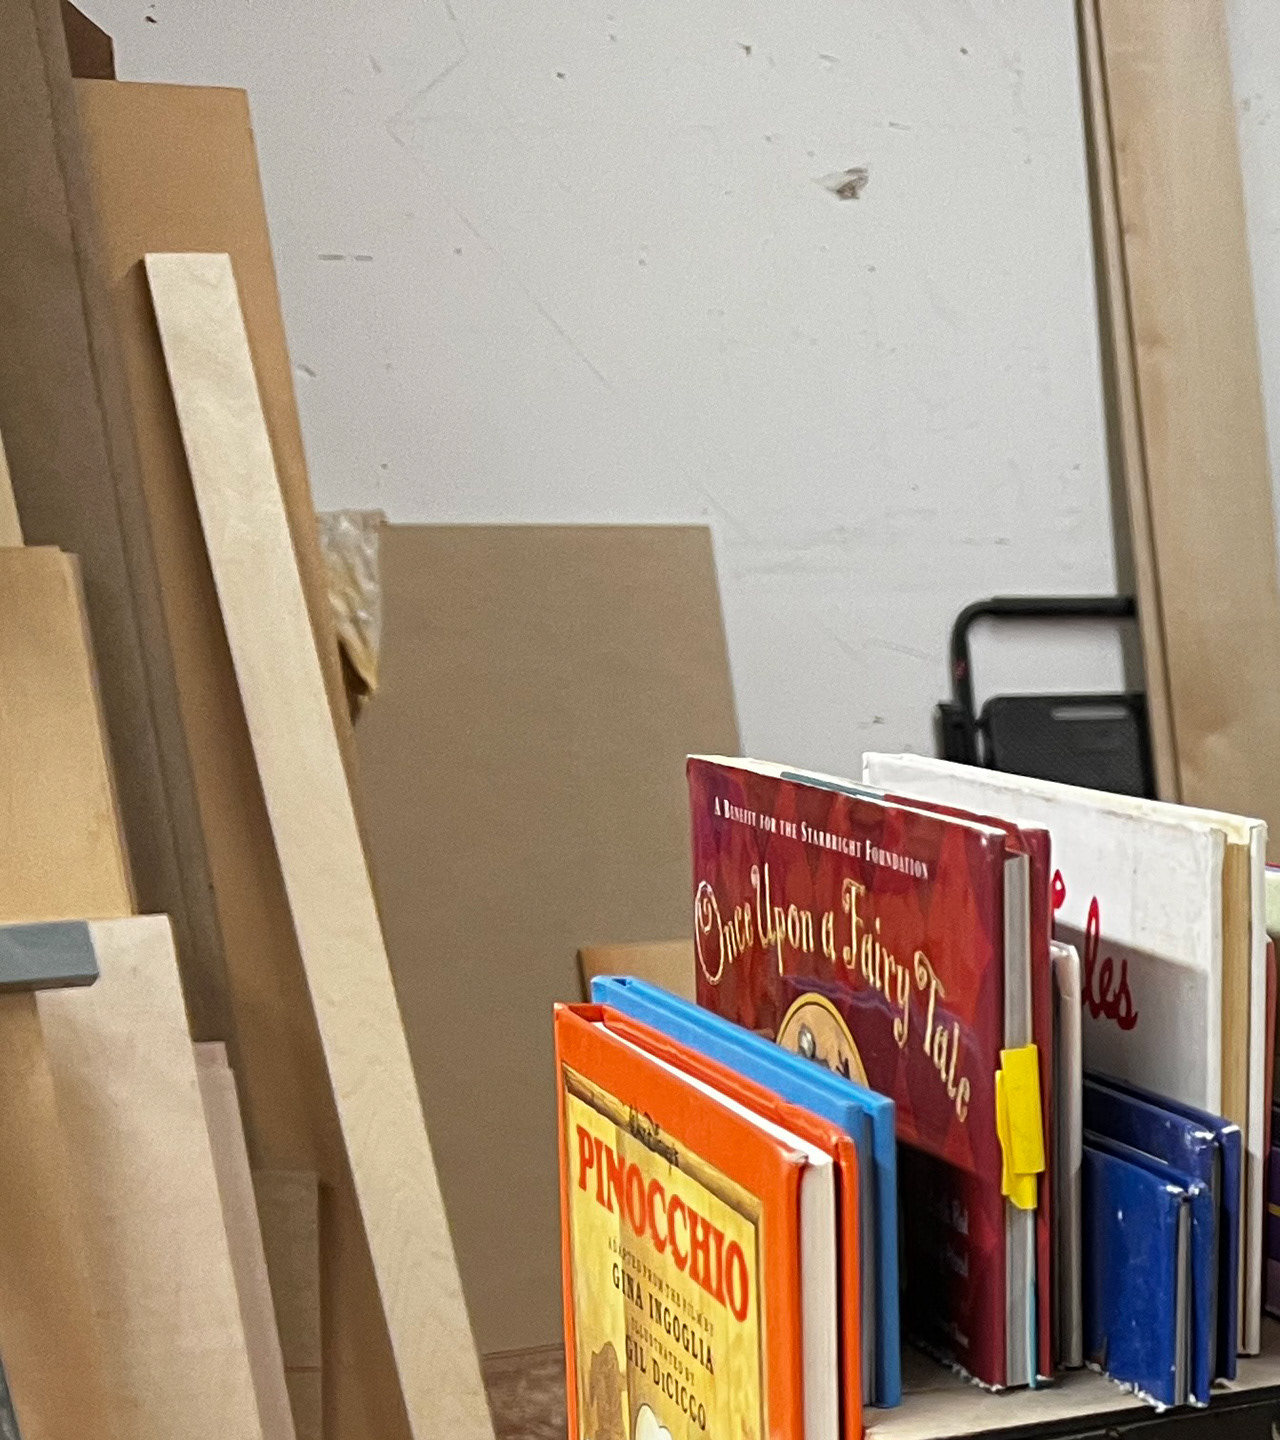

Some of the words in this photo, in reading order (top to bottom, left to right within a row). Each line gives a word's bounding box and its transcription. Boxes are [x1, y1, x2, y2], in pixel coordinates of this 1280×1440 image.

[714, 796, 721, 816] A
[780, 820, 797, 839] THE
[695, 880, 754, 986] Once
[751, 863, 815, 976] Upon
[821, 911, 836, 959] a
[842, 877, 910, 1048] Fairy
[914, 950, 970, 1122] Tale
[1082, 896, 1138, 1031] les
[576, 1125, 749, 1323] PINOCCHIO
[612, 1263, 644, 1310] GINA
[648, 1292, 714, 1375] INGOGLIA
[625, 1334, 647, 1374] GIL
